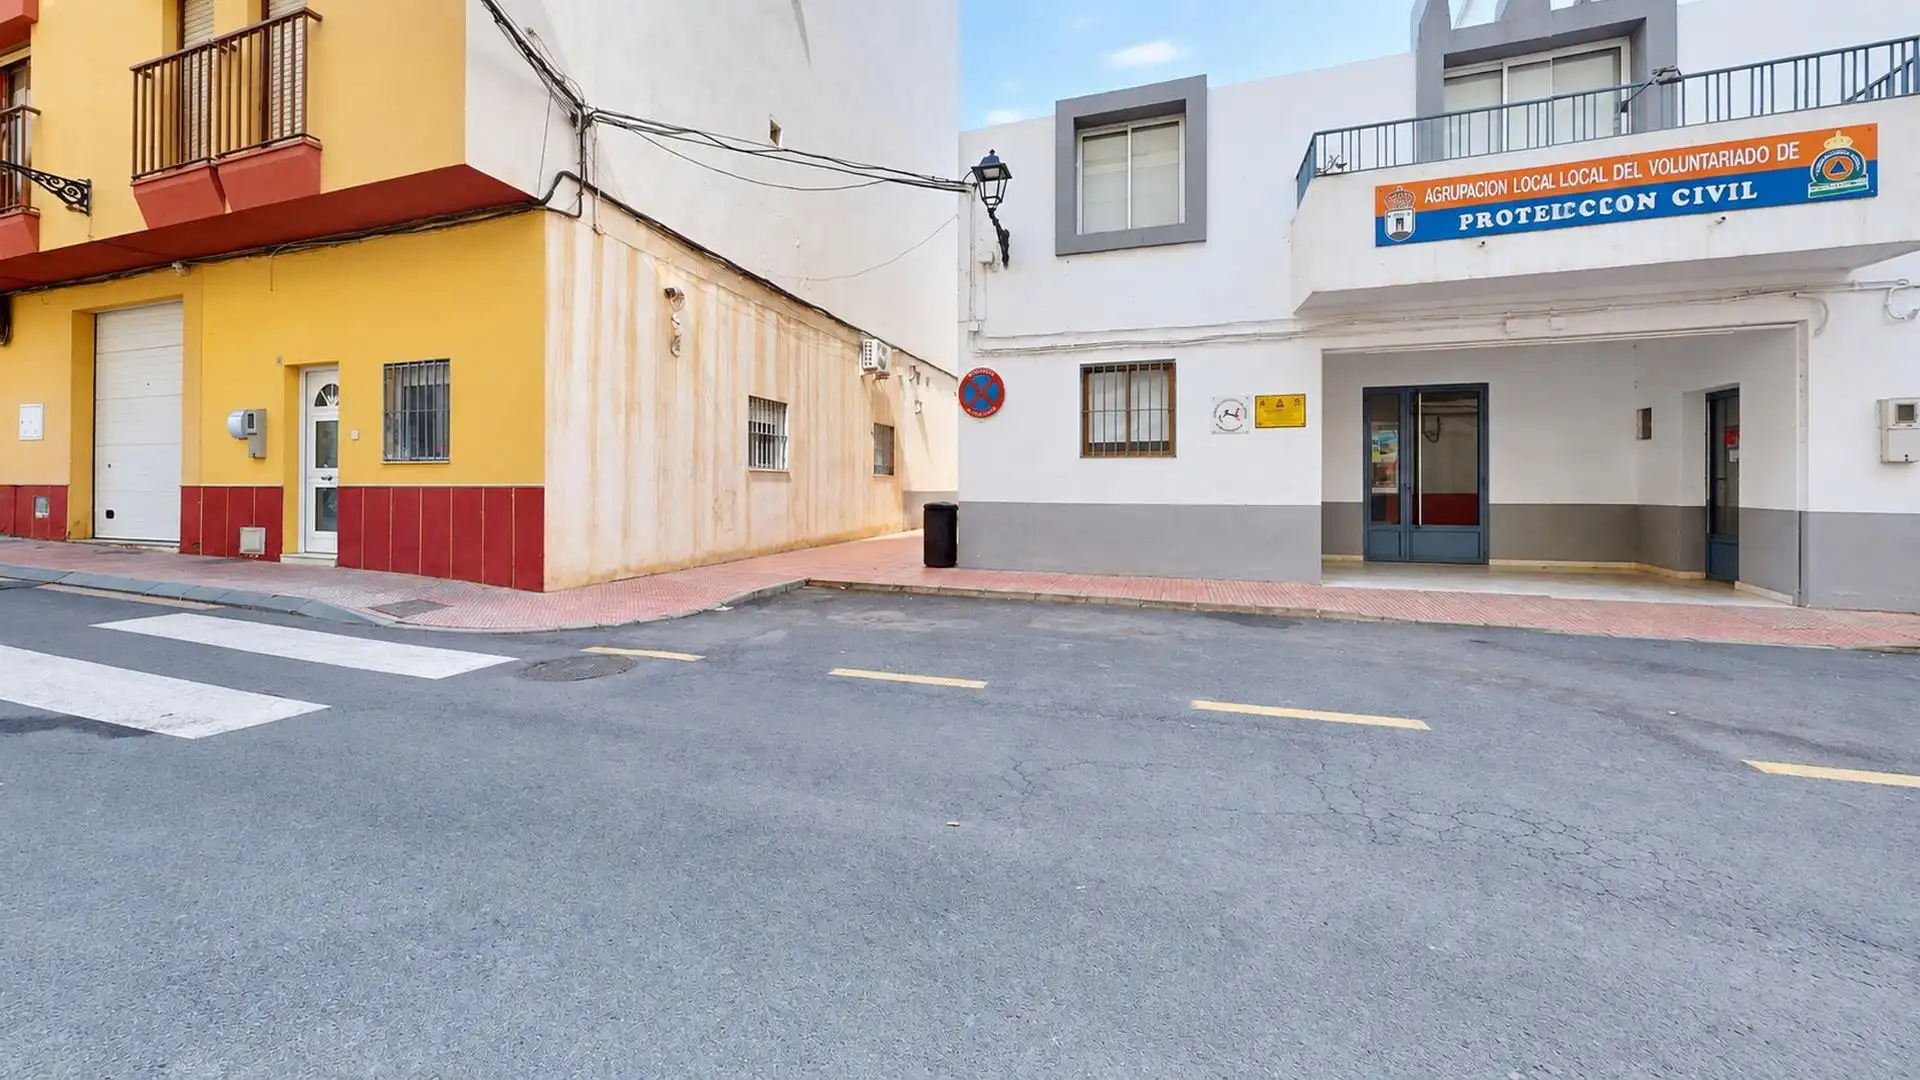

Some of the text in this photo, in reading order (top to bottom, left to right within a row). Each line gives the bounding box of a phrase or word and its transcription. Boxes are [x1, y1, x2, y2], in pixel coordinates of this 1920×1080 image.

[1424, 141, 1800, 203] AGRUPACION LOCAL LOCAL DEL VOLUNTARIADO DE
[1671, 181, 1758, 206] CIVIL
